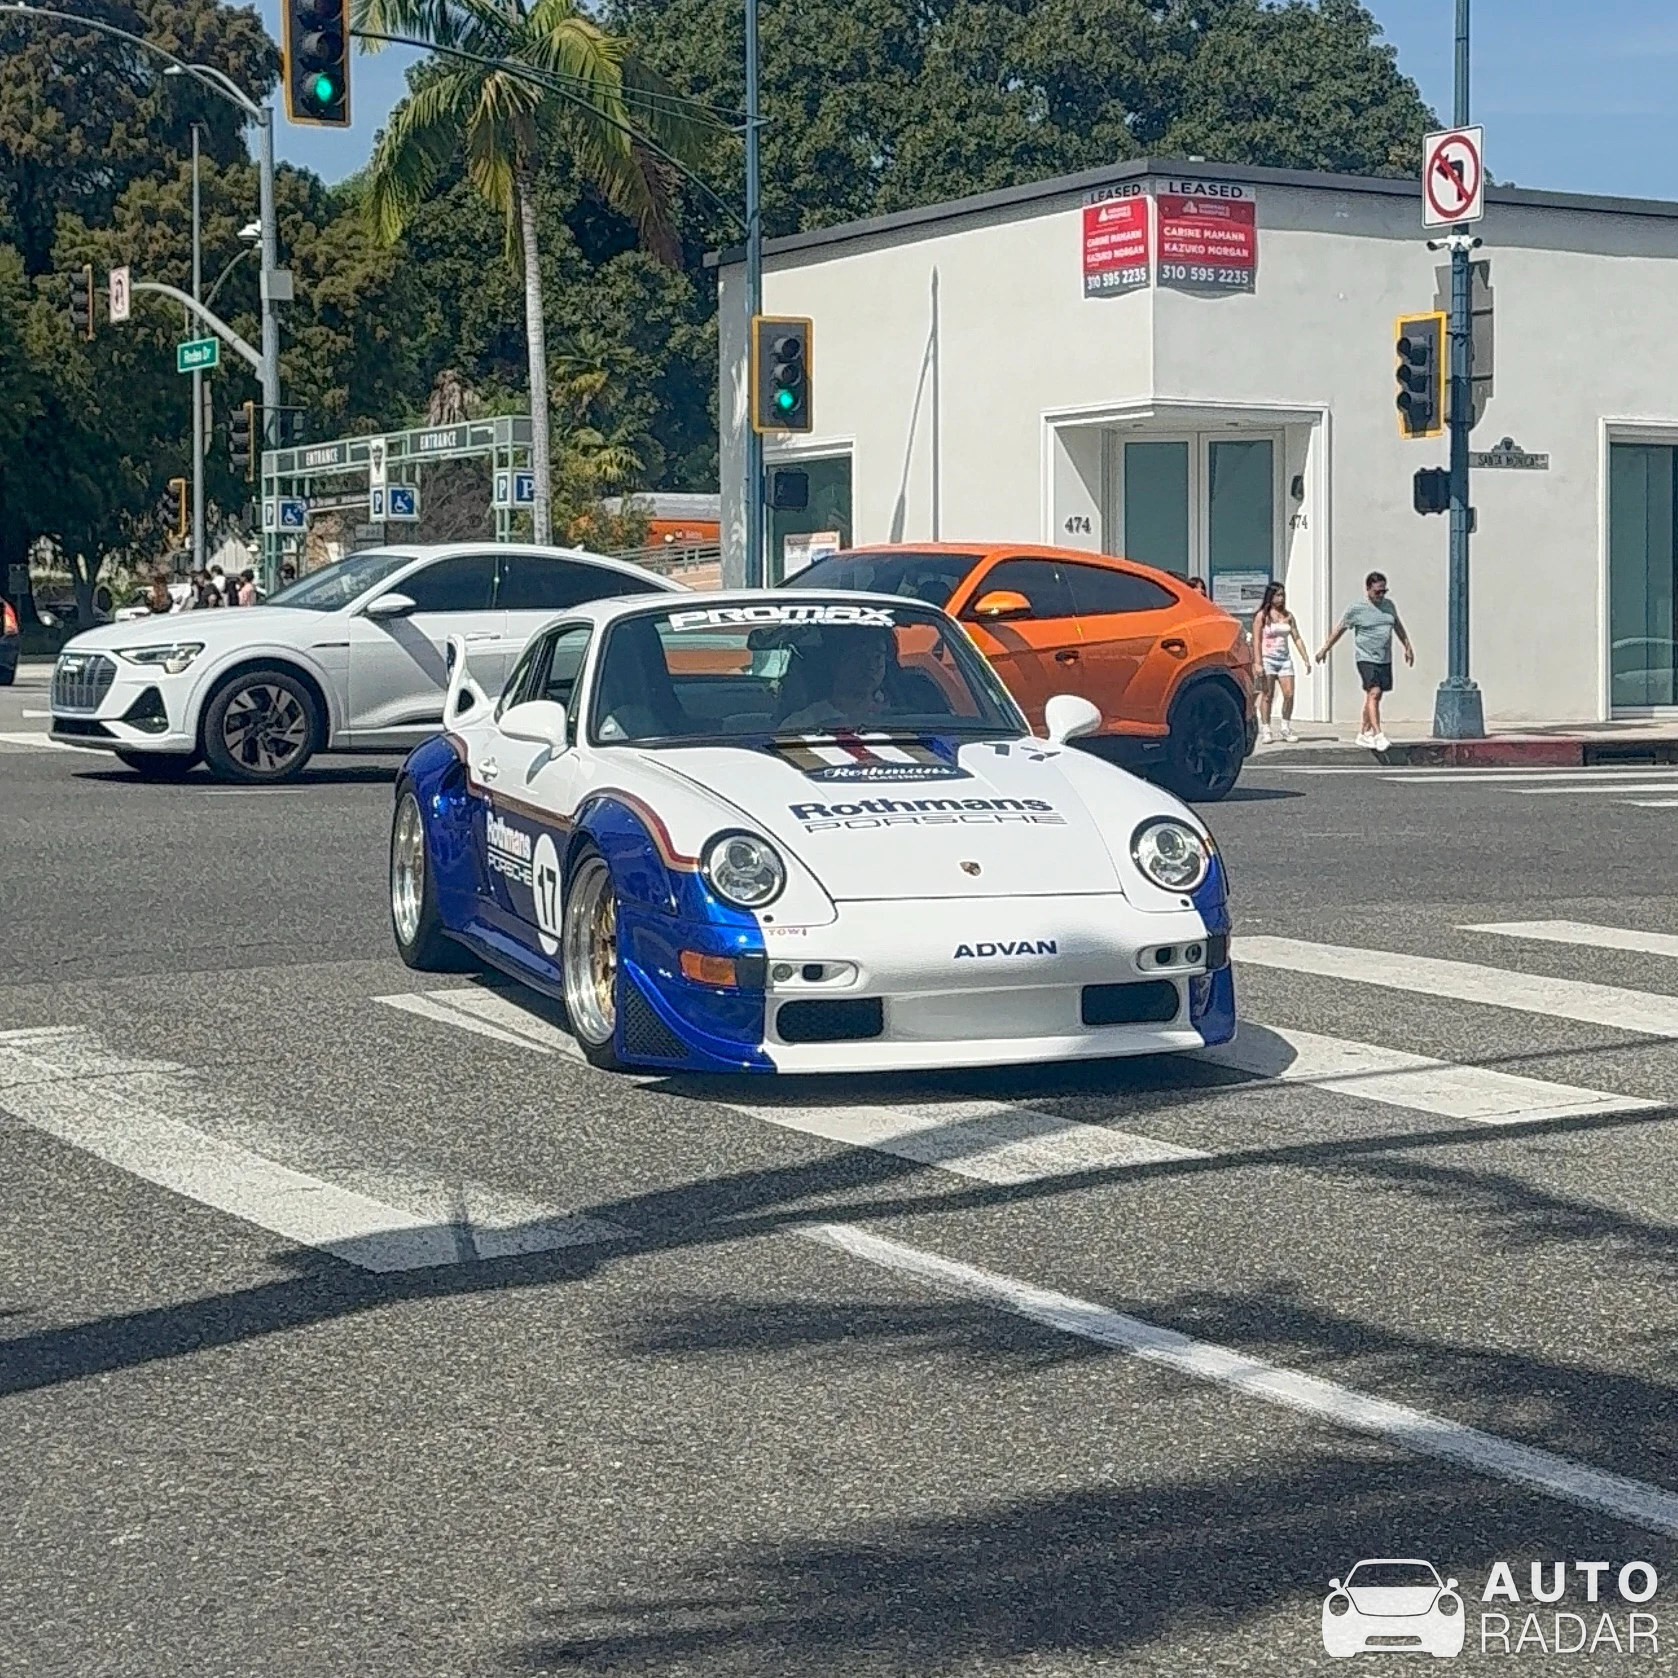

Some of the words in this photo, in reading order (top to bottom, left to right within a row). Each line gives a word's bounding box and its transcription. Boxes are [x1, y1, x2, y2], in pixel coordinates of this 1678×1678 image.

[1091, 184, 1141, 204] LEASED
[1169, 181, 1243, 198] LEASED
[1163, 243, 1205, 255] KAZUKO
[1208, 246, 1249, 257] MORGAN
[1102, 271, 1120, 287] 595
[1122, 267, 1147, 283] 2235
[1162, 265, 1186, 279] 310
[1191, 267, 1215, 281] 595
[1218, 269, 1249, 284] 2235
[419, 431, 457, 450] ENTRANCE
[305, 447, 338, 466] ENTRANCE
[499, 479, 506, 499] P
[374, 493, 382, 512] P
[1065, 517, 1091, 533] 474
[1288, 514, 1308, 530] 474
[668, 606, 895, 629] PROMAX
[823, 767, 957, 779] Rothmans
[788, 798, 1054, 821] Rothmans
[805, 813, 1069, 833] PORSCHE
[487, 811, 531, 861] Rothmans
[488, 852, 532, 887] PORSCHE
[538, 864, 556, 931] 17
[953, 940, 1057, 959] ADVAN
